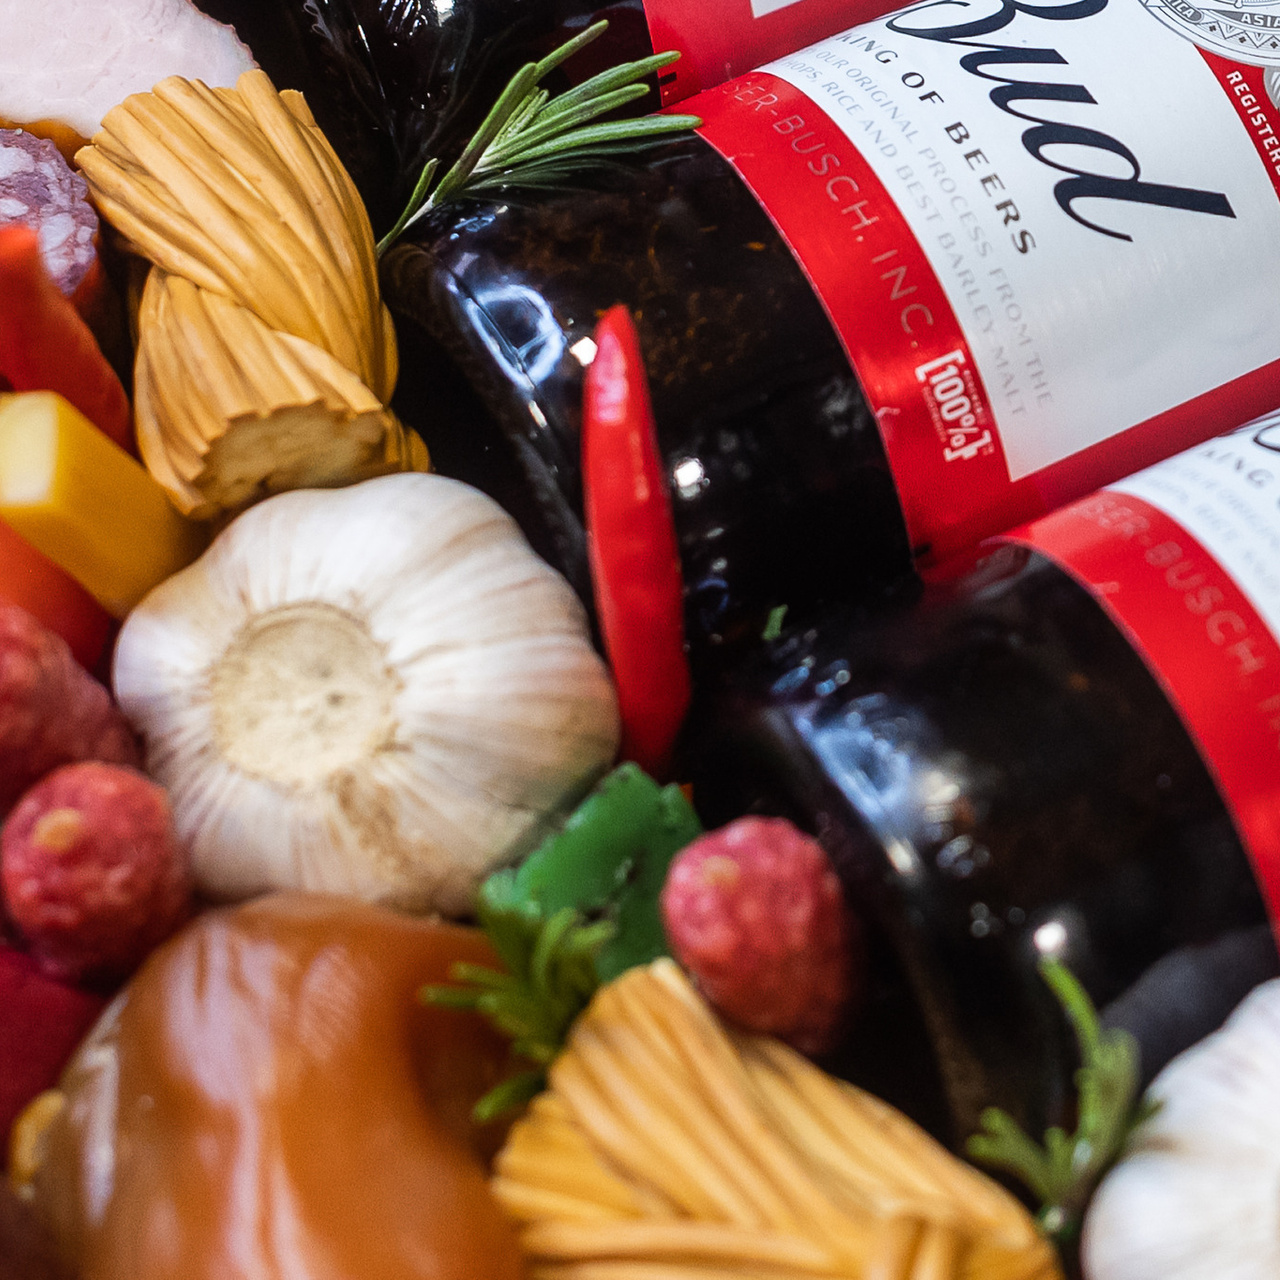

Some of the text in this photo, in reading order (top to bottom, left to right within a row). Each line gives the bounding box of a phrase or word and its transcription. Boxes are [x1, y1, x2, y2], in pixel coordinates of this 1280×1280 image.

[816, 50, 1053, 409] OUR ORIGINAL PROCESS FROM THE
[821, 81, 864, 116] RICE
[860, 120, 898, 159] AND
[896, 165, 943, 222] BEST
[938, 232, 995, 334] BARLEY
[993, 346, 1026, 415] MALT
[836, 32, 1036, 254] KING OF BEERS
[872, 249, 933, 347] INC.
